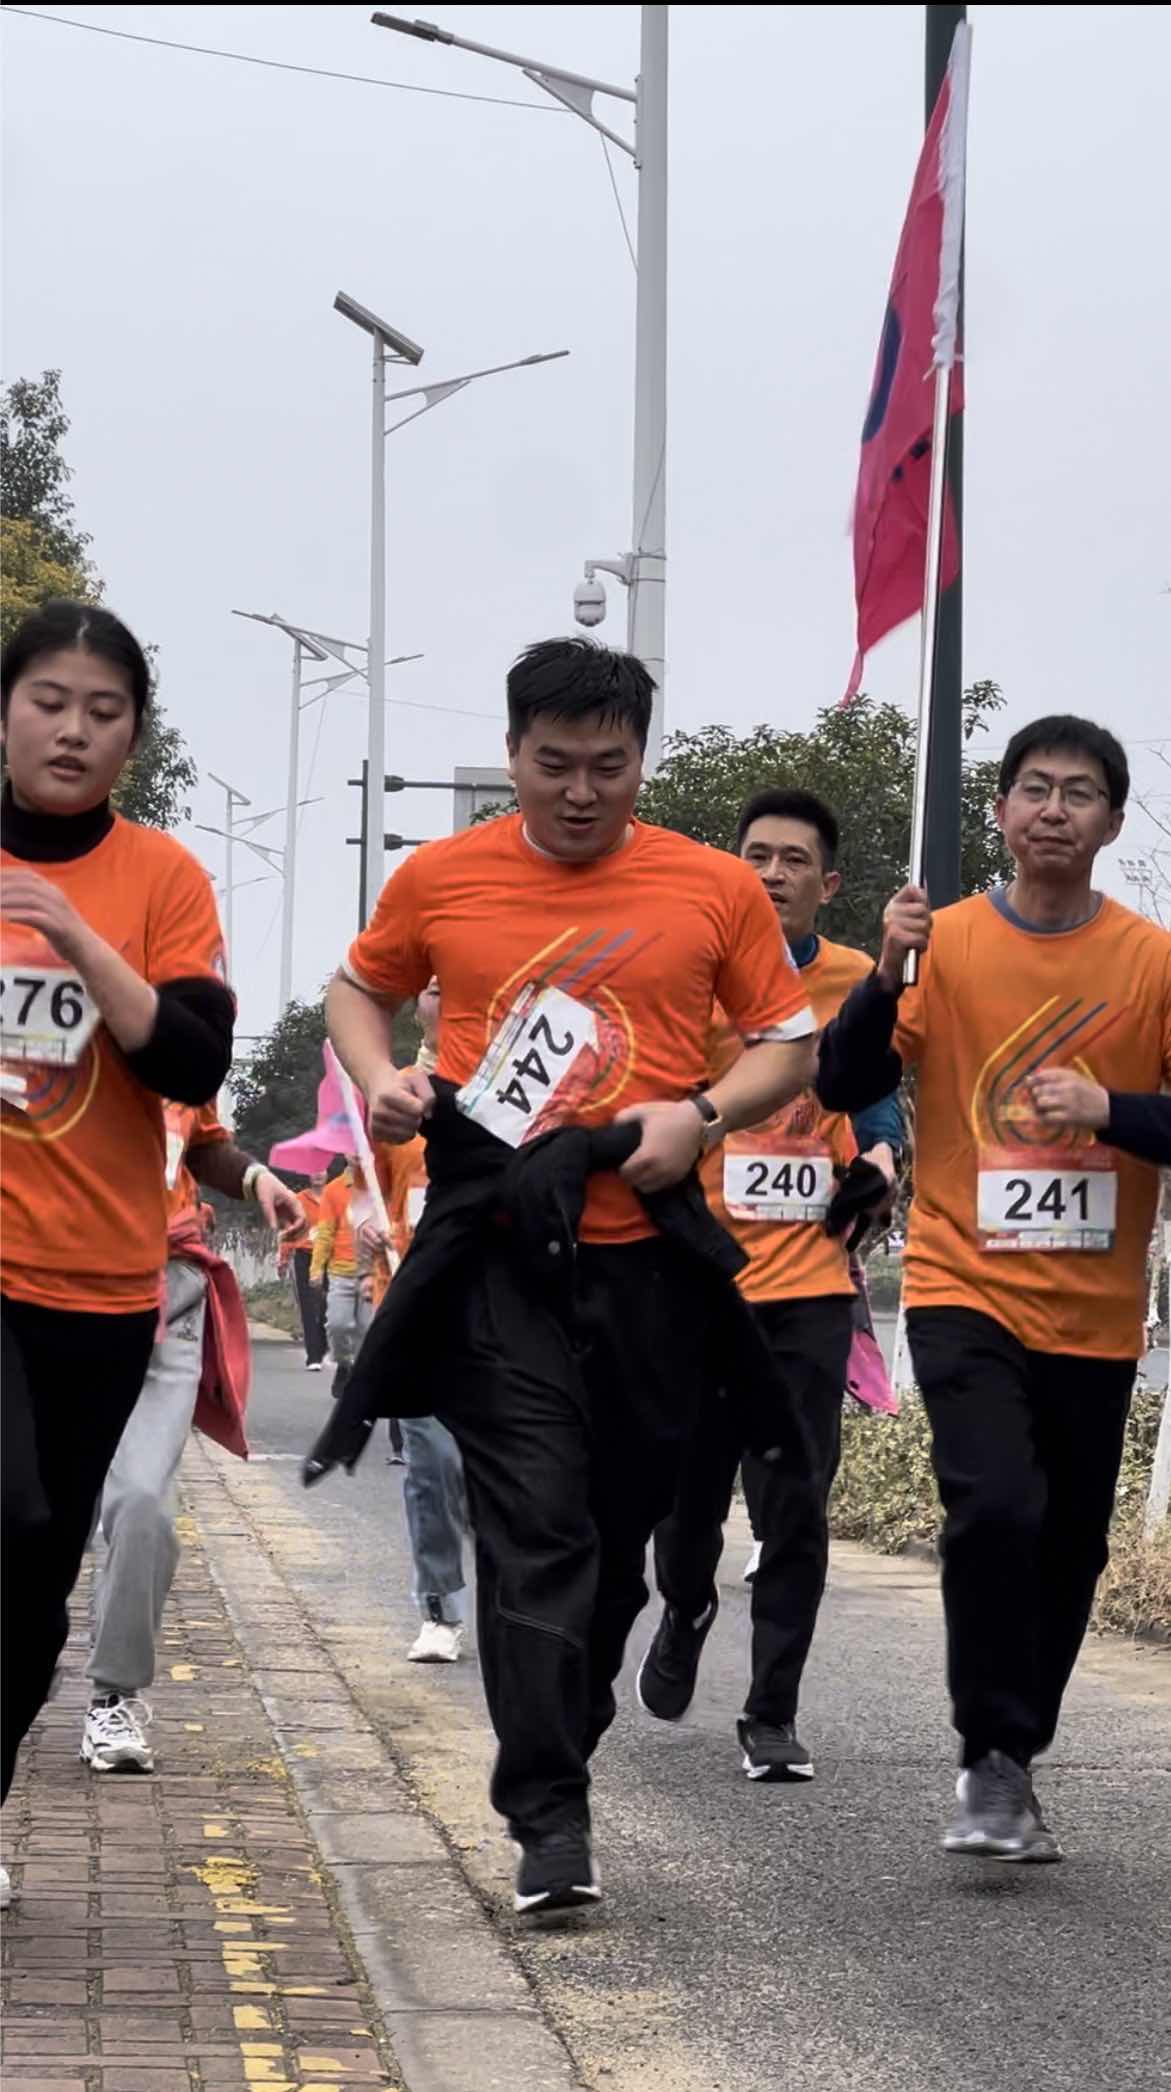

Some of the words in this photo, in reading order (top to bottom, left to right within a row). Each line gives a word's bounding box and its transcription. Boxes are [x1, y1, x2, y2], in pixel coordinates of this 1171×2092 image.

[0, 978, 84, 1029] 76
[496, 1014, 575, 1115] 244
[745, 1161, 817, 1198] 240
[1004, 1178, 1090, 1221] 241
